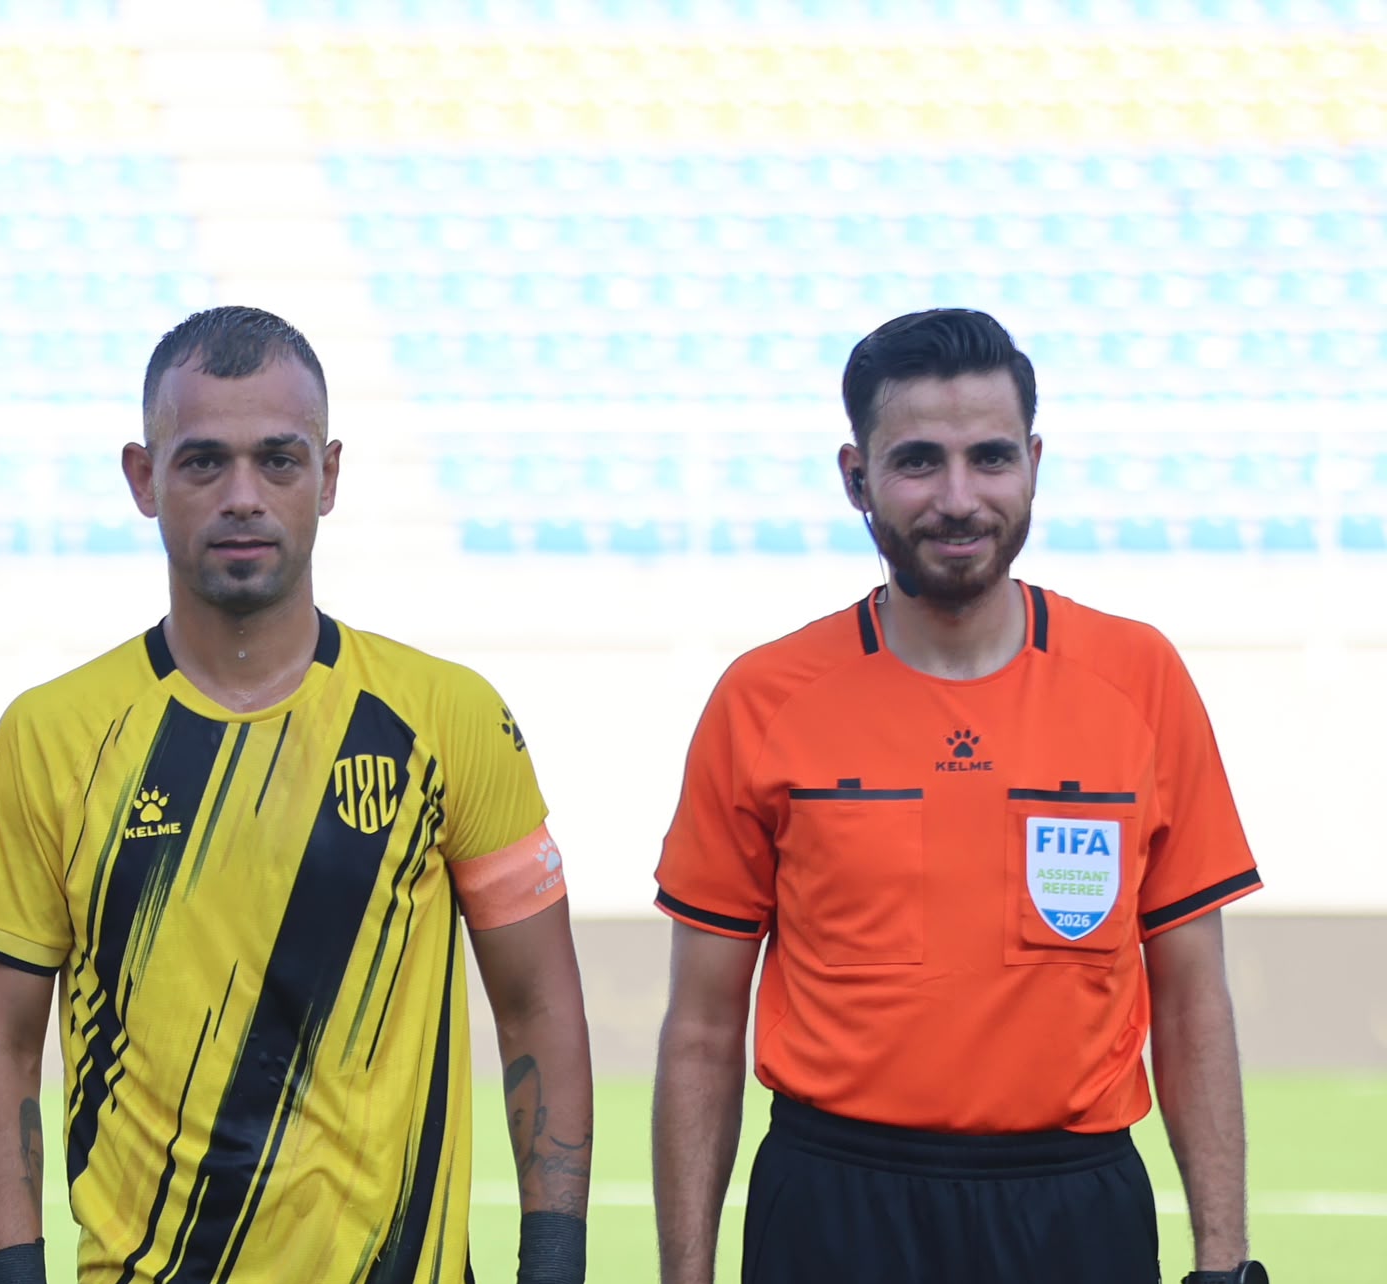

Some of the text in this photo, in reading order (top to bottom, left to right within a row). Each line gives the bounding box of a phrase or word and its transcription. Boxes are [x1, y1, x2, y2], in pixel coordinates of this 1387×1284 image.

[935, 761, 993, 773] KELME
[124, 822, 182, 840] KELME
[1035, 826, 1110, 856] FIFA
[1037, 868, 1110, 882] ASSISTANT
[1042, 882, 1104, 896] REFEREE
[1055, 913, 1091, 928] 2026
